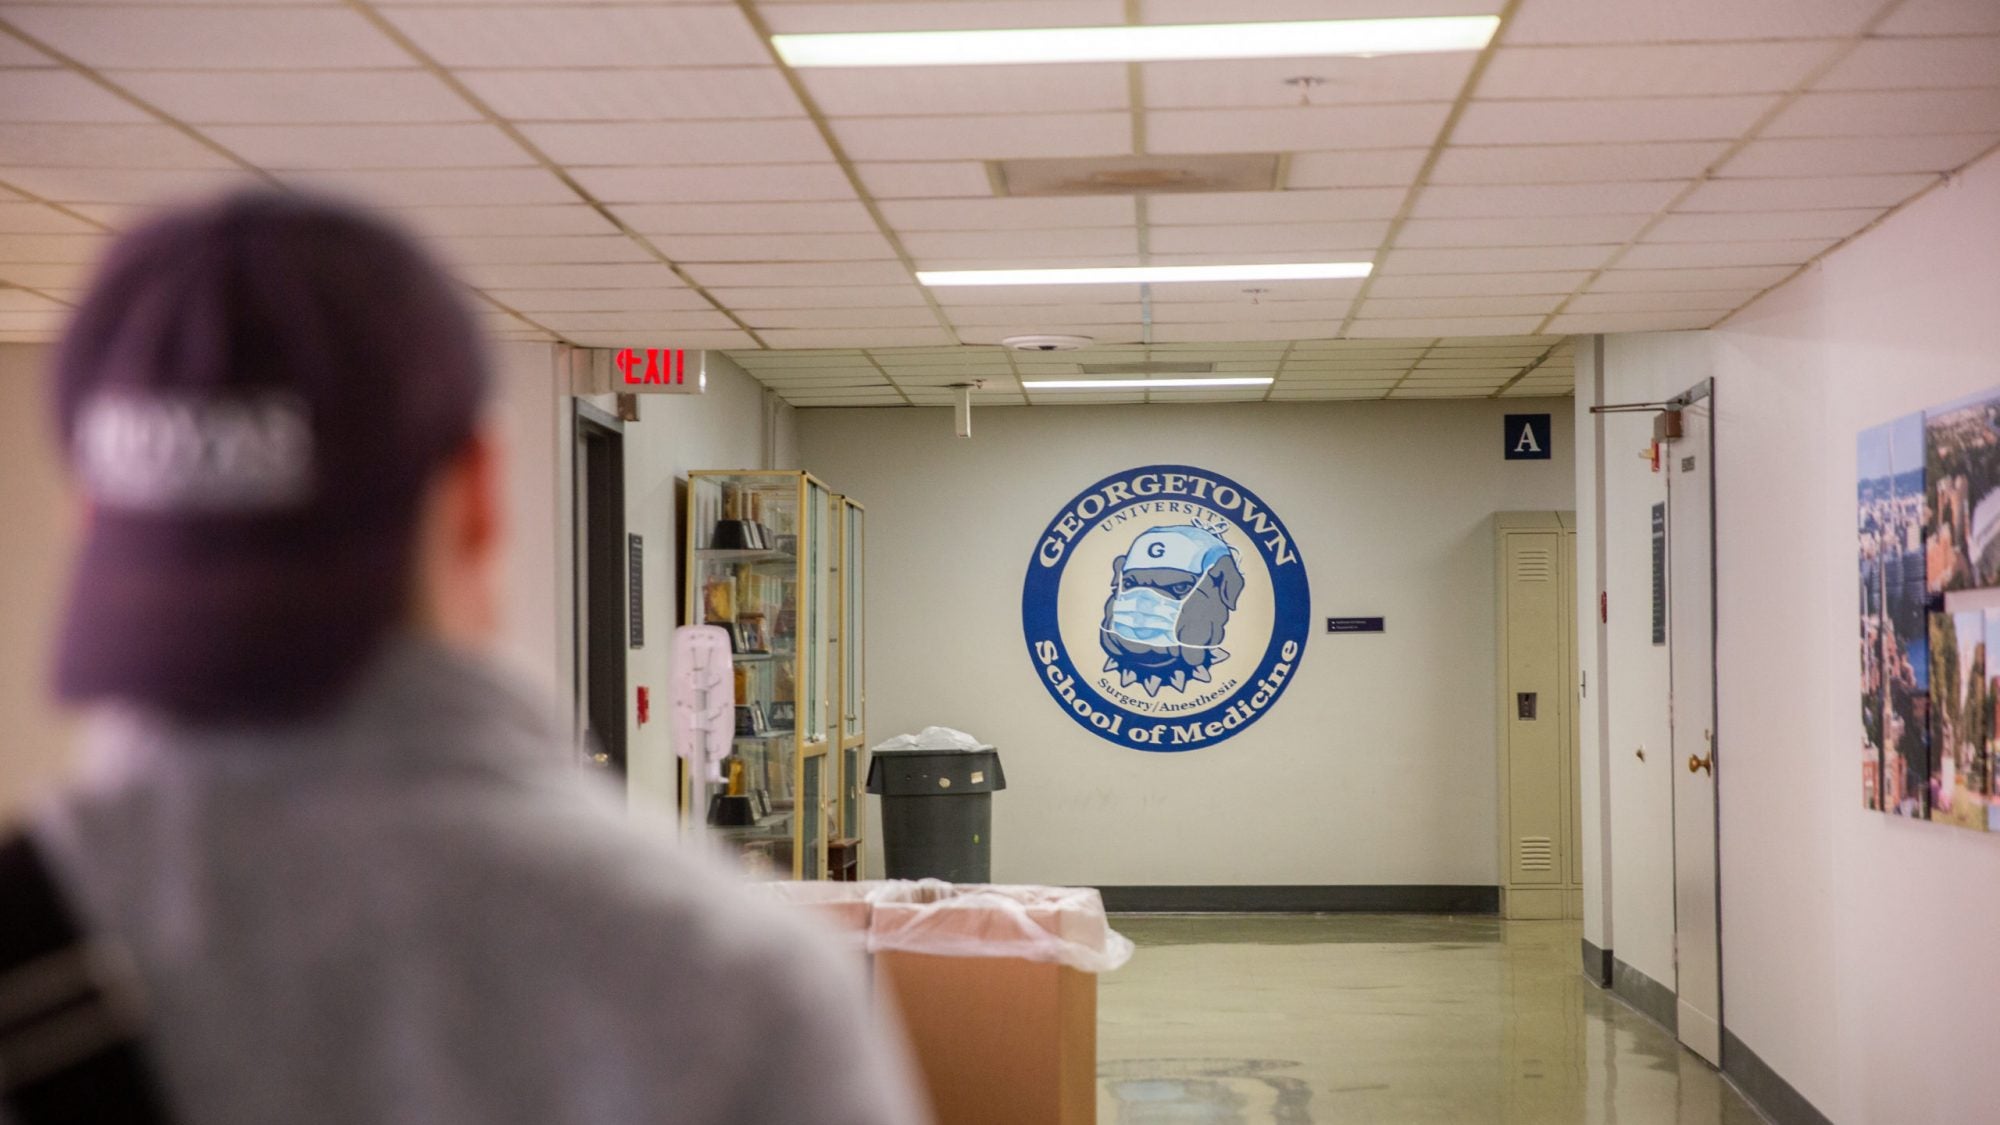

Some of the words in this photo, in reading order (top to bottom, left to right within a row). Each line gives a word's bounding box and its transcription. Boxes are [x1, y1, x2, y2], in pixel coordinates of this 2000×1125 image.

[1515, 422, 1541, 452] A
[1039, 473, 1296, 568] GEORGETOWN
[1147, 542, 1165, 559] G
[1035, 640, 1121, 735] School
[1129, 725, 1166, 744] of
[1171, 639, 1298, 745] Medicine
[1097, 677, 1238, 714] Surgery/Anesthesia
